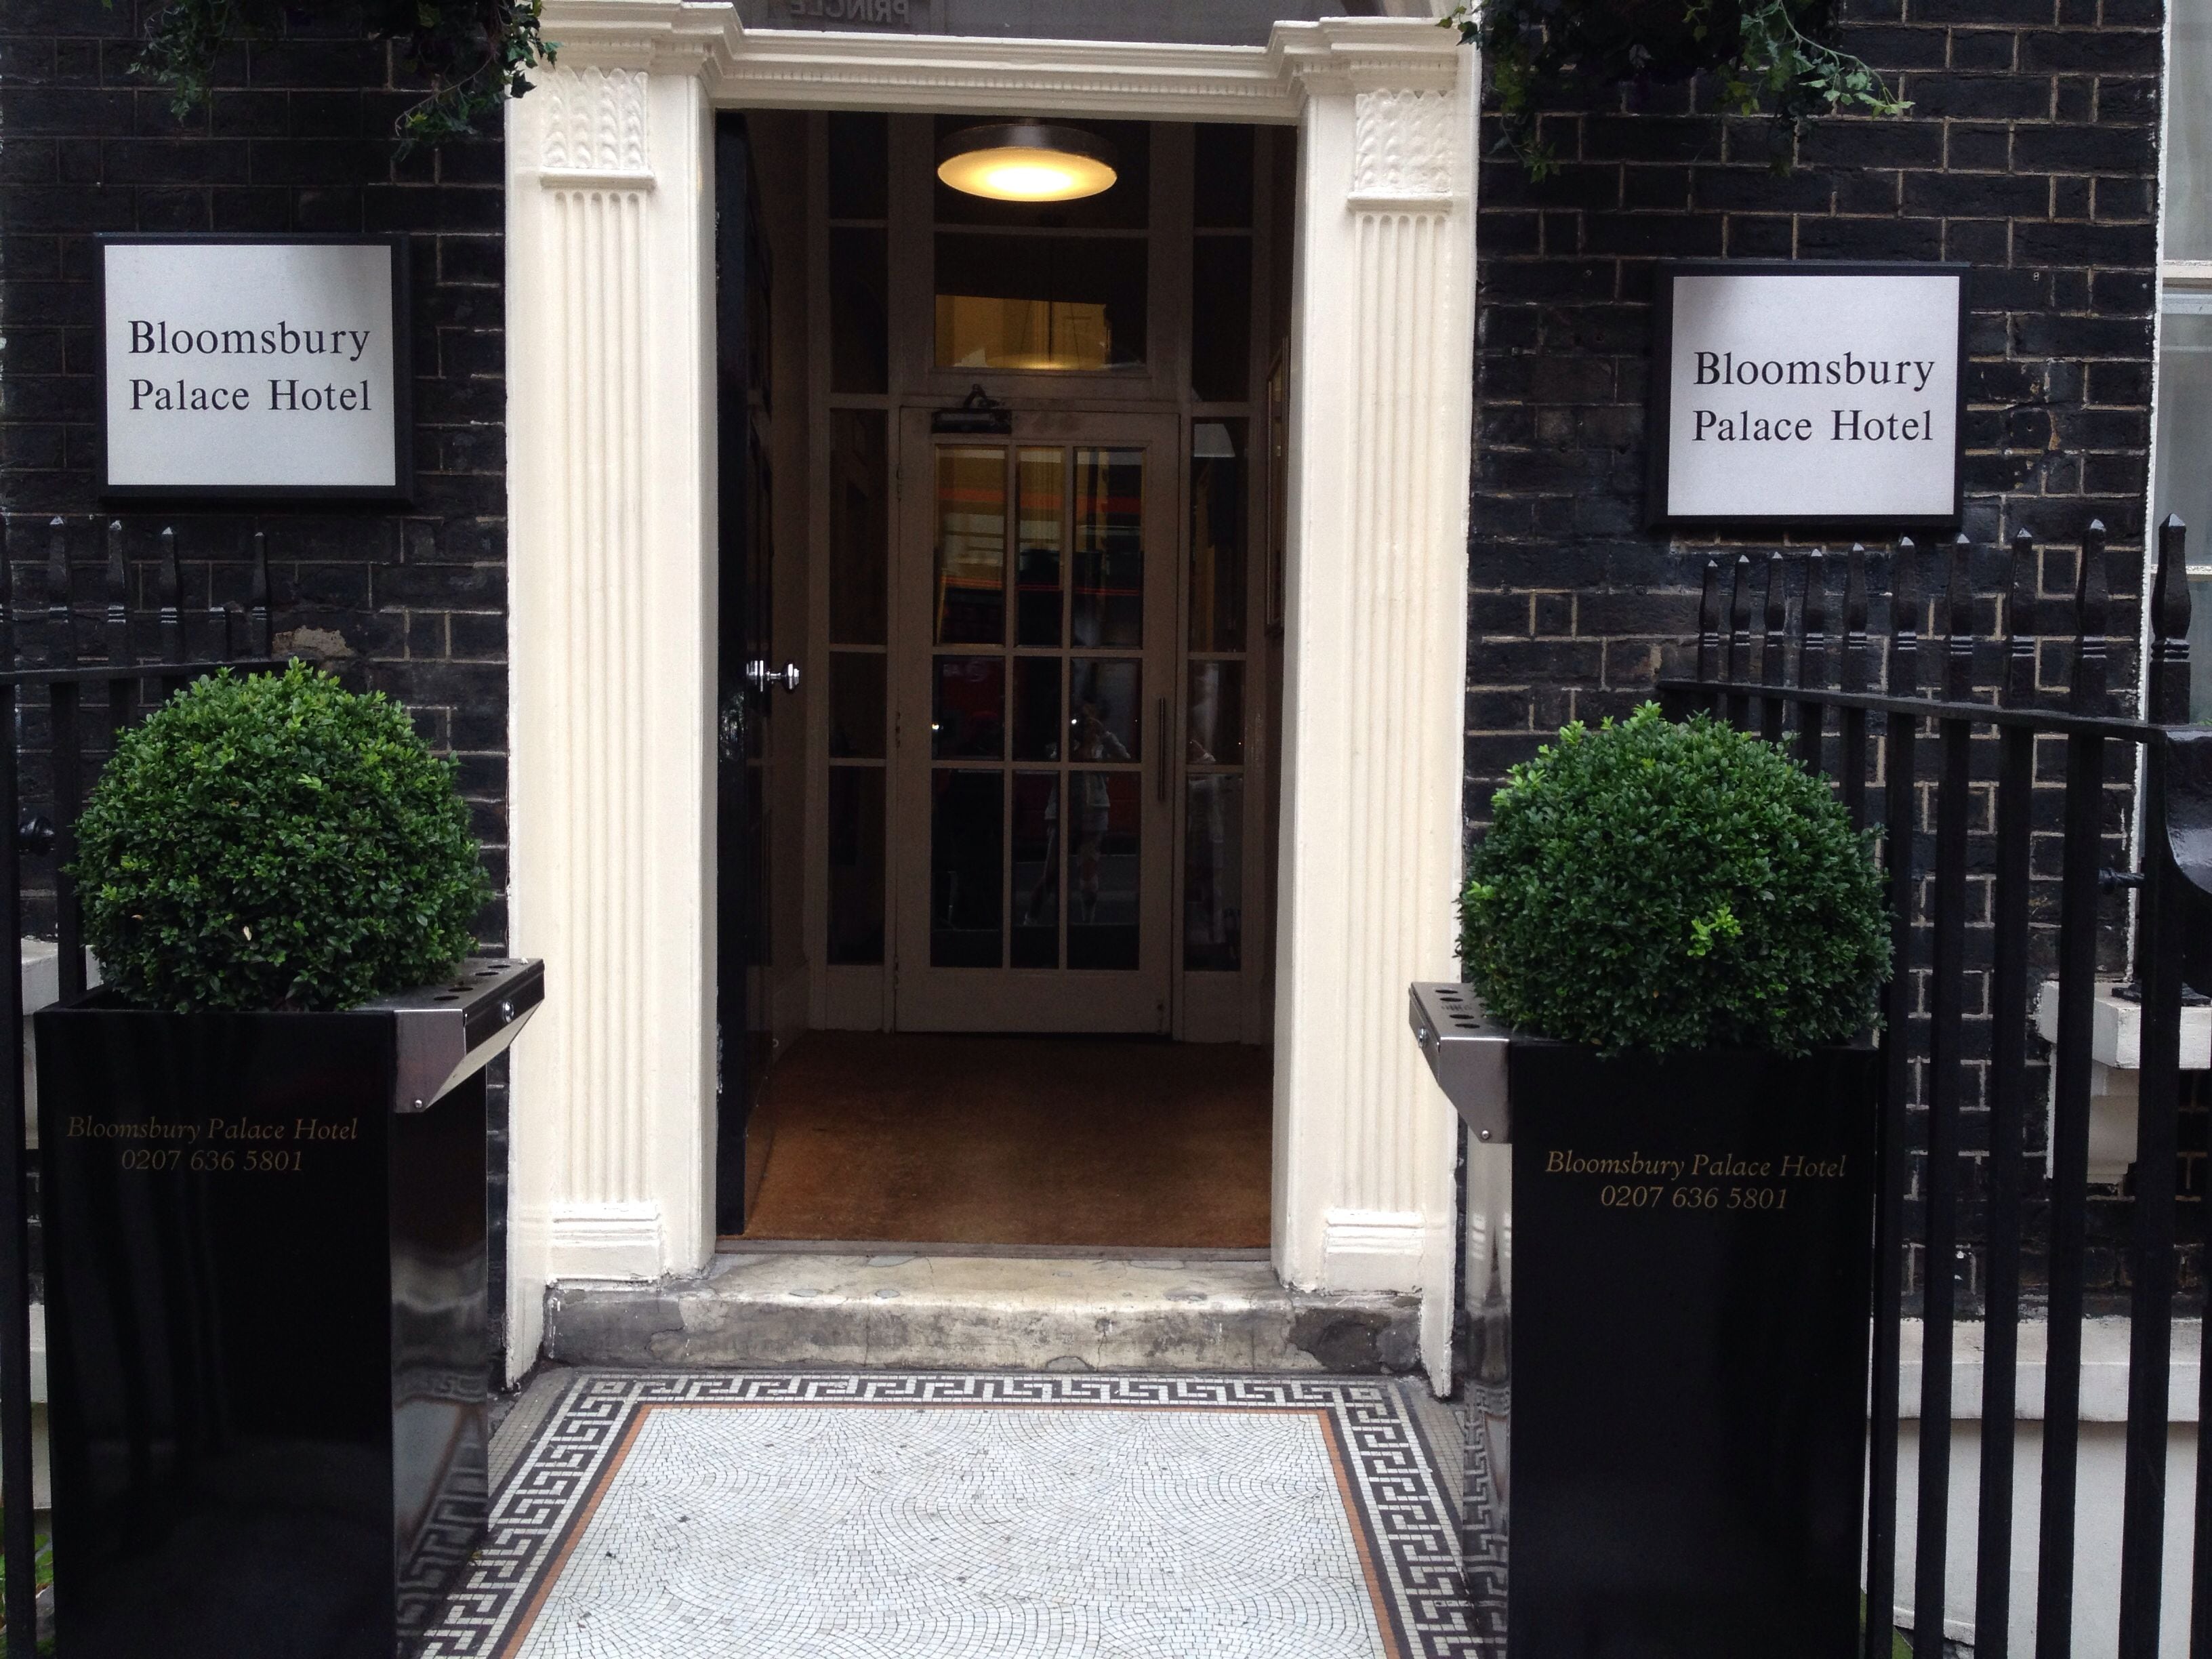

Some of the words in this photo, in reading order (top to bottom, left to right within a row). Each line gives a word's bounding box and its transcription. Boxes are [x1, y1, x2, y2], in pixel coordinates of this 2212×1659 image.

[127, 320, 370, 362] Bloomsbury
[1694, 351, 1936, 392] Bloomsbury
[129, 379, 249, 411] Palace
[268, 379, 371, 411] Hotel
[1692, 410, 1812, 442] Palace
[1830, 409, 1933, 441] Hotel
[66, 1115, 201, 1144] Bloomsbury
[207, 1116, 285, 1140] Palace
[293, 1117, 358, 1140] Hotel
[121, 1149, 182, 1170] 0207
[190, 1149, 234, 1171] 636
[243, 1150, 302, 1171] 5801
[1544, 1149, 1685, 1181] Bloomsbury
[1691, 1153, 1771, 1176] Palace
[1780, 1154, 1847, 1178] Hotel
[1600, 1185, 1664, 1208] 0207
[1672, 1186, 1719, 1209] 636
[1726, 1187, 1787, 1210] 5801
